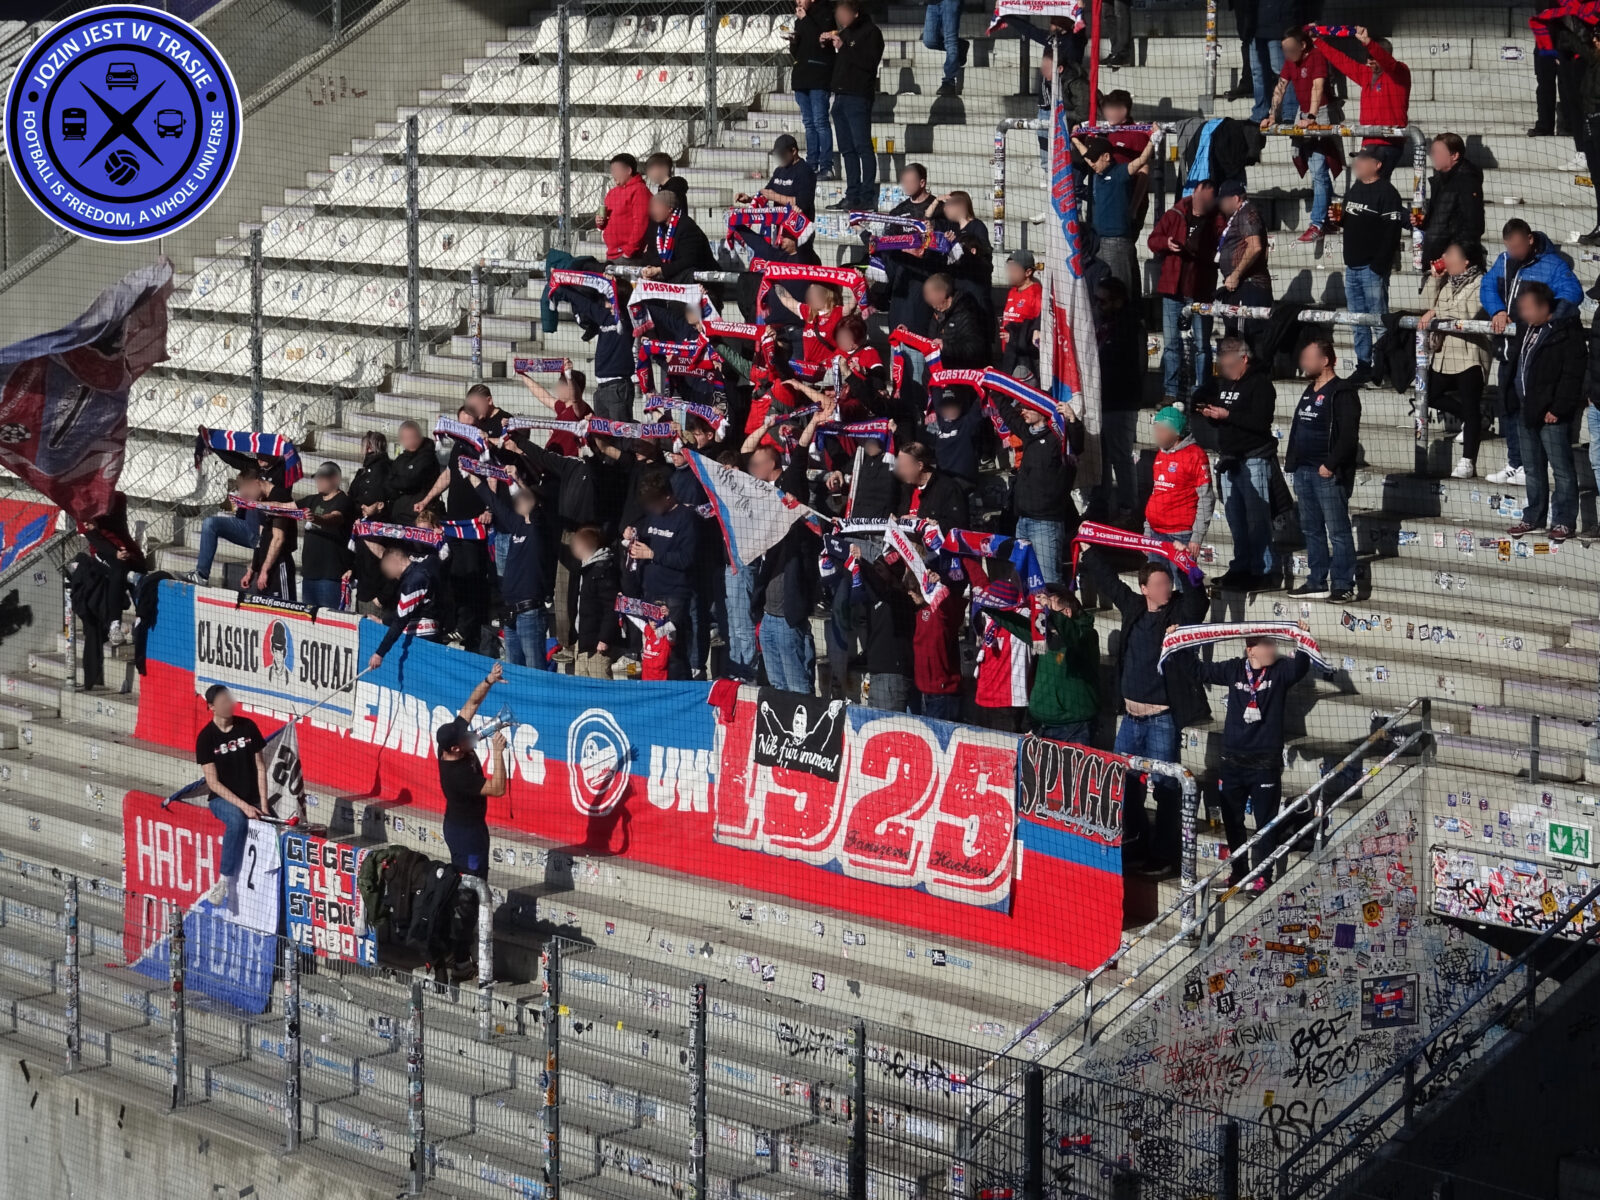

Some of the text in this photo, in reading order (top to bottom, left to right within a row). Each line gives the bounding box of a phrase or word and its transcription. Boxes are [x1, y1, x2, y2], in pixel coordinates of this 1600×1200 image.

[642, 282, 687, 295] VORSTADT
[197, 619, 354, 693] CLASSIC SQUAD
[758, 733, 840, 774] Nik für immer!
[136, 815, 224, 894] HACH
[247, 843, 258, 891] 2
[286, 835, 357, 876] GEGE
[287, 864, 354, 901] ALL
